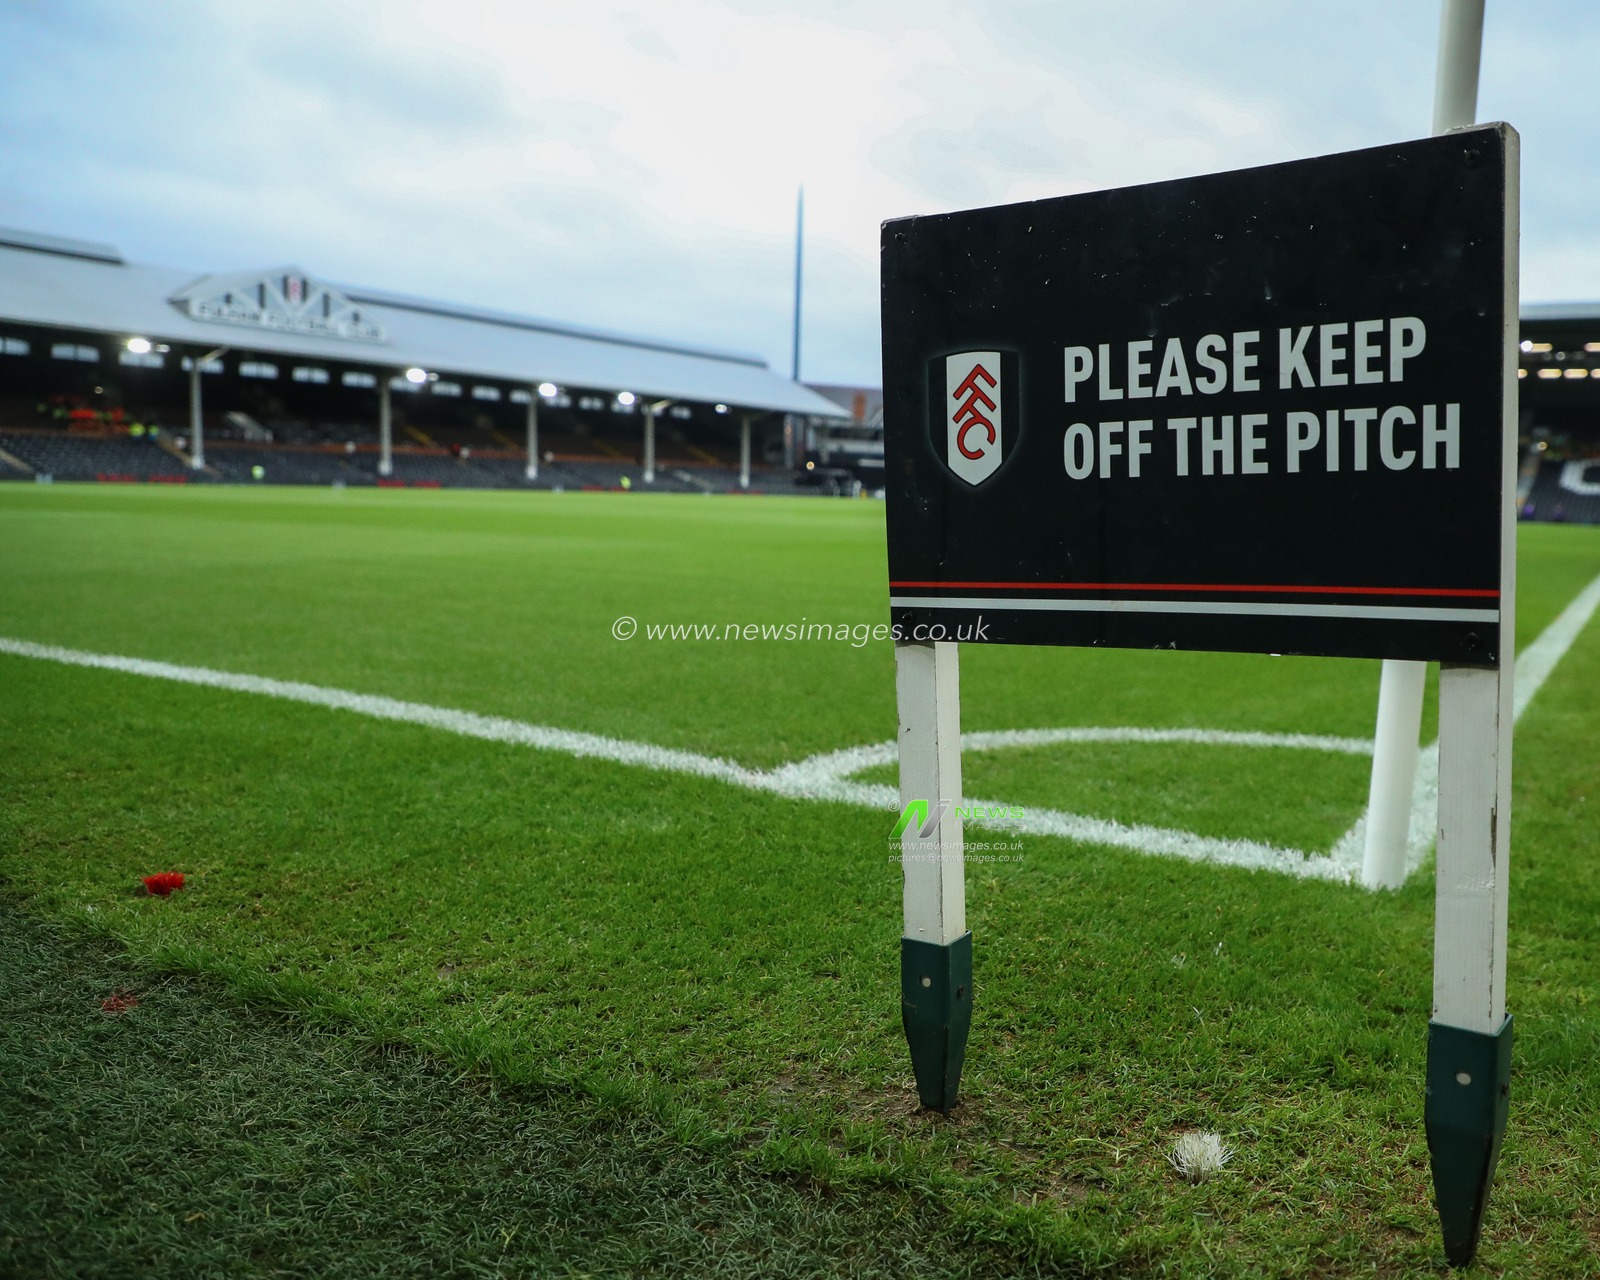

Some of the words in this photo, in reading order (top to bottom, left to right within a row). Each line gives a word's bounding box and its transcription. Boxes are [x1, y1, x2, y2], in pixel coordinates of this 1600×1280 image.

[1064, 330, 1260, 403] PLEASE
[1279, 316, 1426, 390] KEEP
[1063, 420, 1154, 480] OFF
[1167, 413, 1269, 477] THE
[1286, 403, 1461, 474] PITCH
